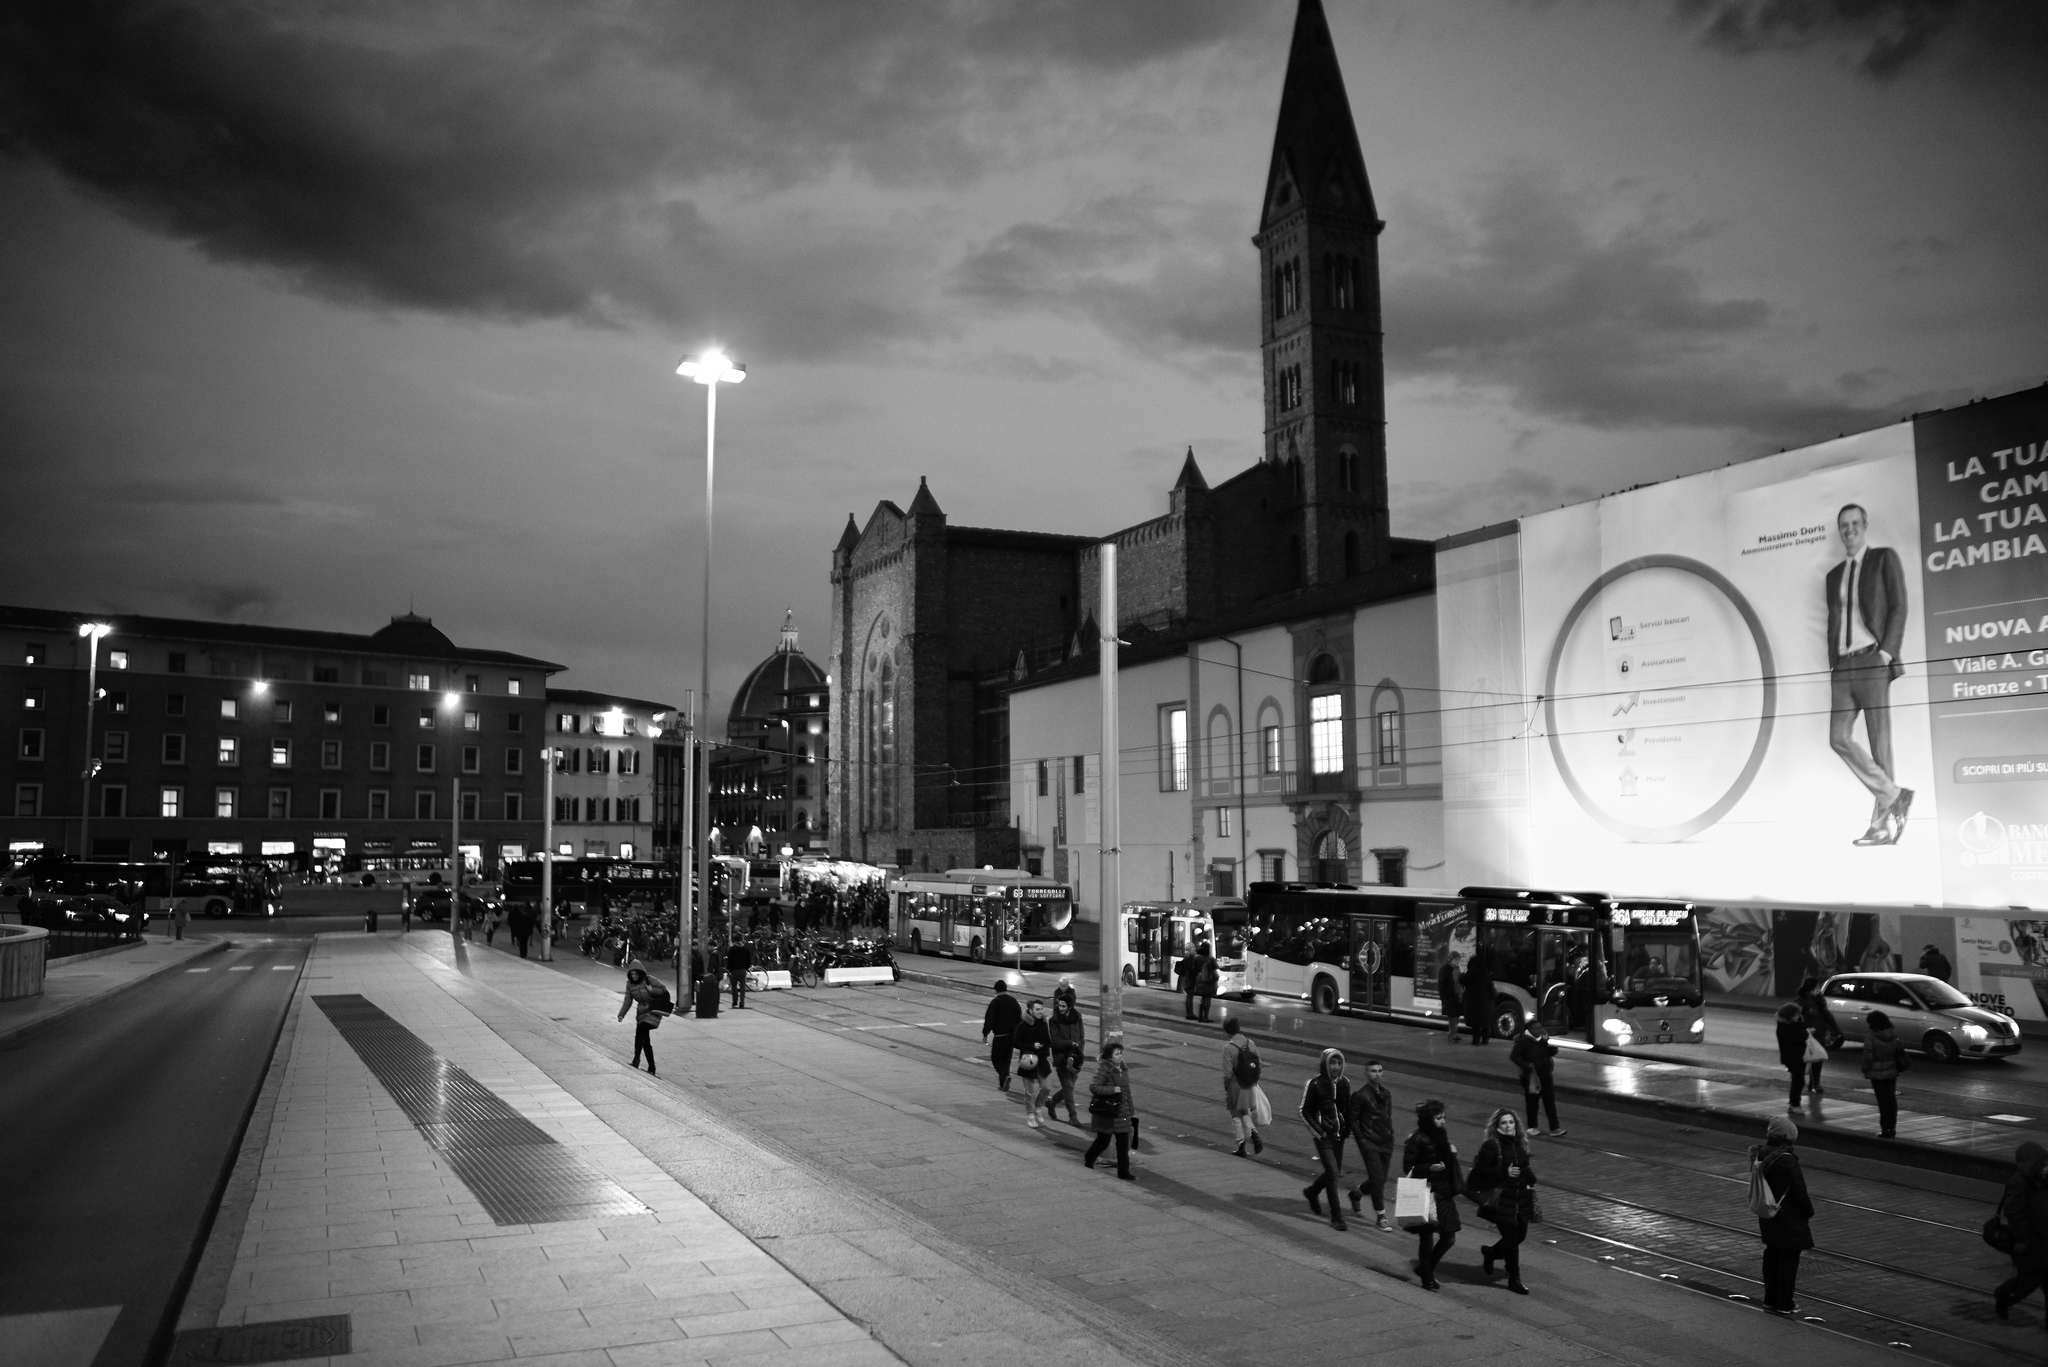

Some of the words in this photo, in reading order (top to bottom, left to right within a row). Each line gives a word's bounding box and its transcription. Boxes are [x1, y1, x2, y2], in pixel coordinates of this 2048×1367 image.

[1947, 456, 1986, 482] LA
[1979, 470, 2048, 503] CAM
[1934, 517, 1971, 543] LA
[1976, 503, 2047, 533] TUA
[1758, 531, 1798, 544] Massimo
[1800, 524, 1825, 536] Doris
[1741, 542, 1793, 556] Amministratore
[1795, 535, 1826, 546] Delegato
[1926, 533, 2047, 573] CAMBIA
[1640, 619, 1663, 630] Servizi
[1664, 615, 1690, 627] bancari
[1945, 617, 2032, 644] NUOVA
[1641, 655, 1687, 669] Assicurazioni
[1952, 655, 1997, 674] Viale
[2001, 653, 2023, 670] A.
[1952, 681, 2019, 698] Firenze
[1642, 695, 1686, 706] Investimenti
[1644, 735, 1682, 745] Previdenza
[1961, 764, 2001, 776] SCOPRI
[2002, 763, 2015, 774] DI
[2017, 761, 2035, 773] PIÙ
[1610, 909, 1631, 926] 36A
